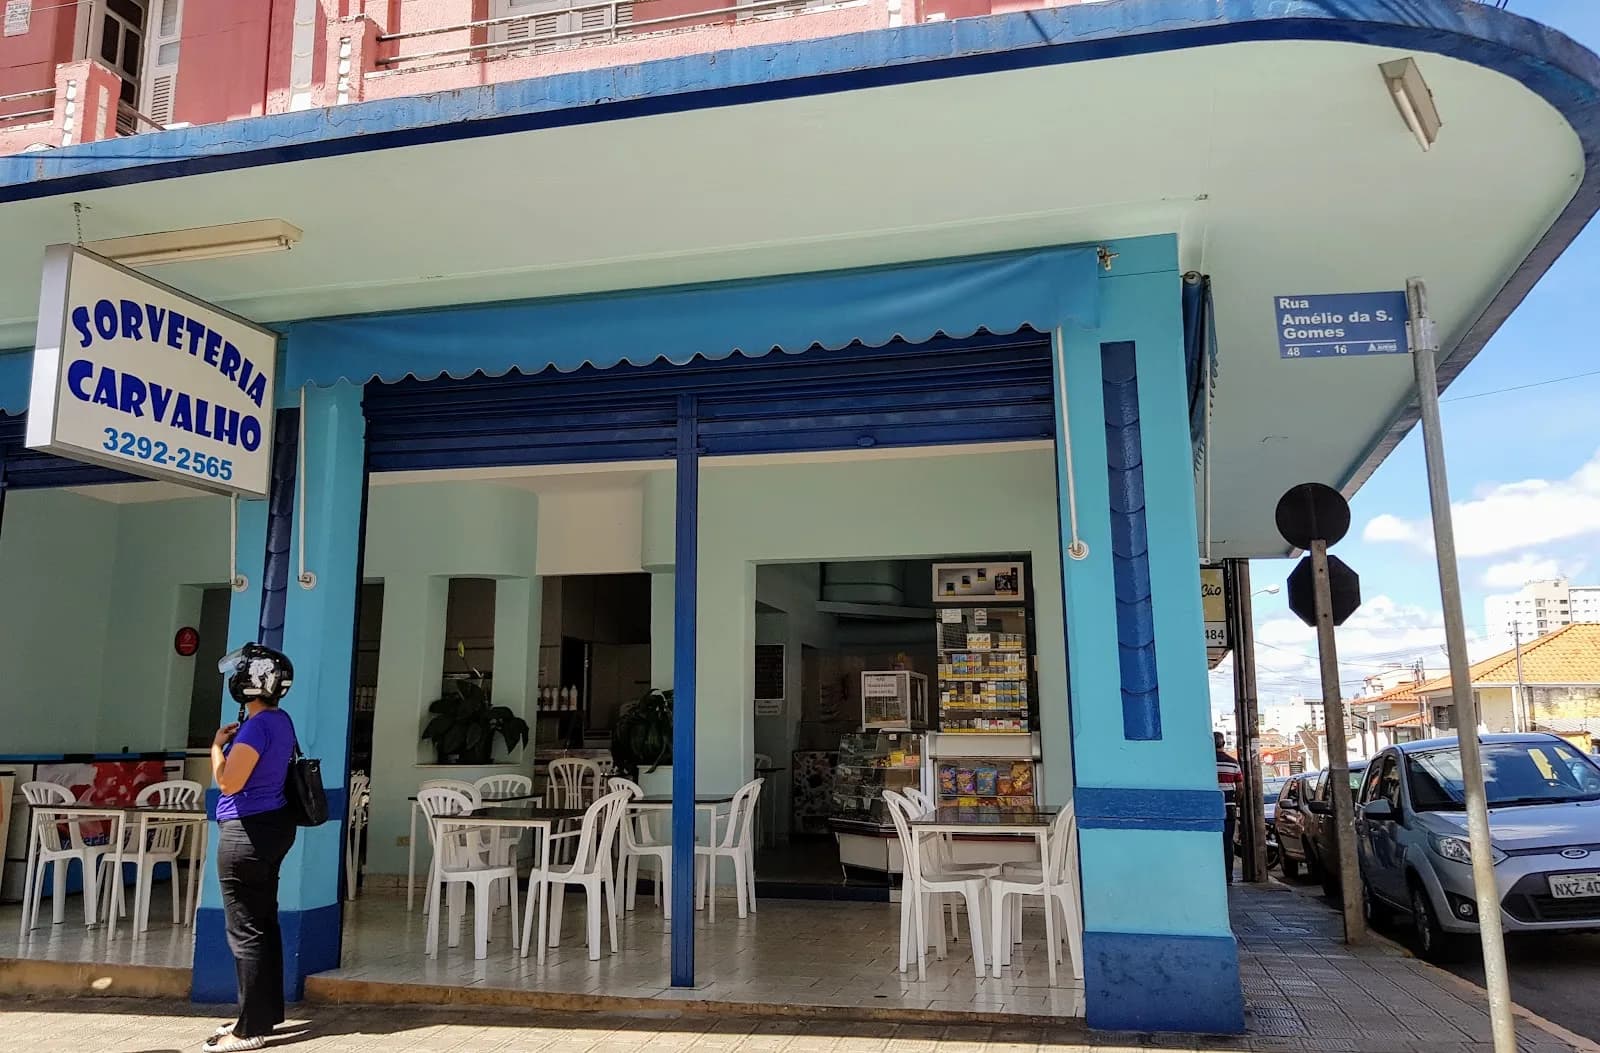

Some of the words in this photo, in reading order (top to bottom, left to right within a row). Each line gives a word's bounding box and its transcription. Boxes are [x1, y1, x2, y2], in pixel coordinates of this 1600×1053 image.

[1279, 298, 1309, 309] Rua
[1282, 312, 1343, 325] Amélio
[1349, 312, 1370, 323] da
[1376, 310, 1393, 322] S.
[1283, 328, 1345, 339] Gomes
[72, 299, 268, 408] SORVETERIA
[1287, 346, 1300, 357] 48
[1334, 345, 1347, 354] 16
[68, 359, 261, 452] CARVALHO
[103, 427, 233, 481] 3292-2565
[1201, 584, 1222, 597] Cão
